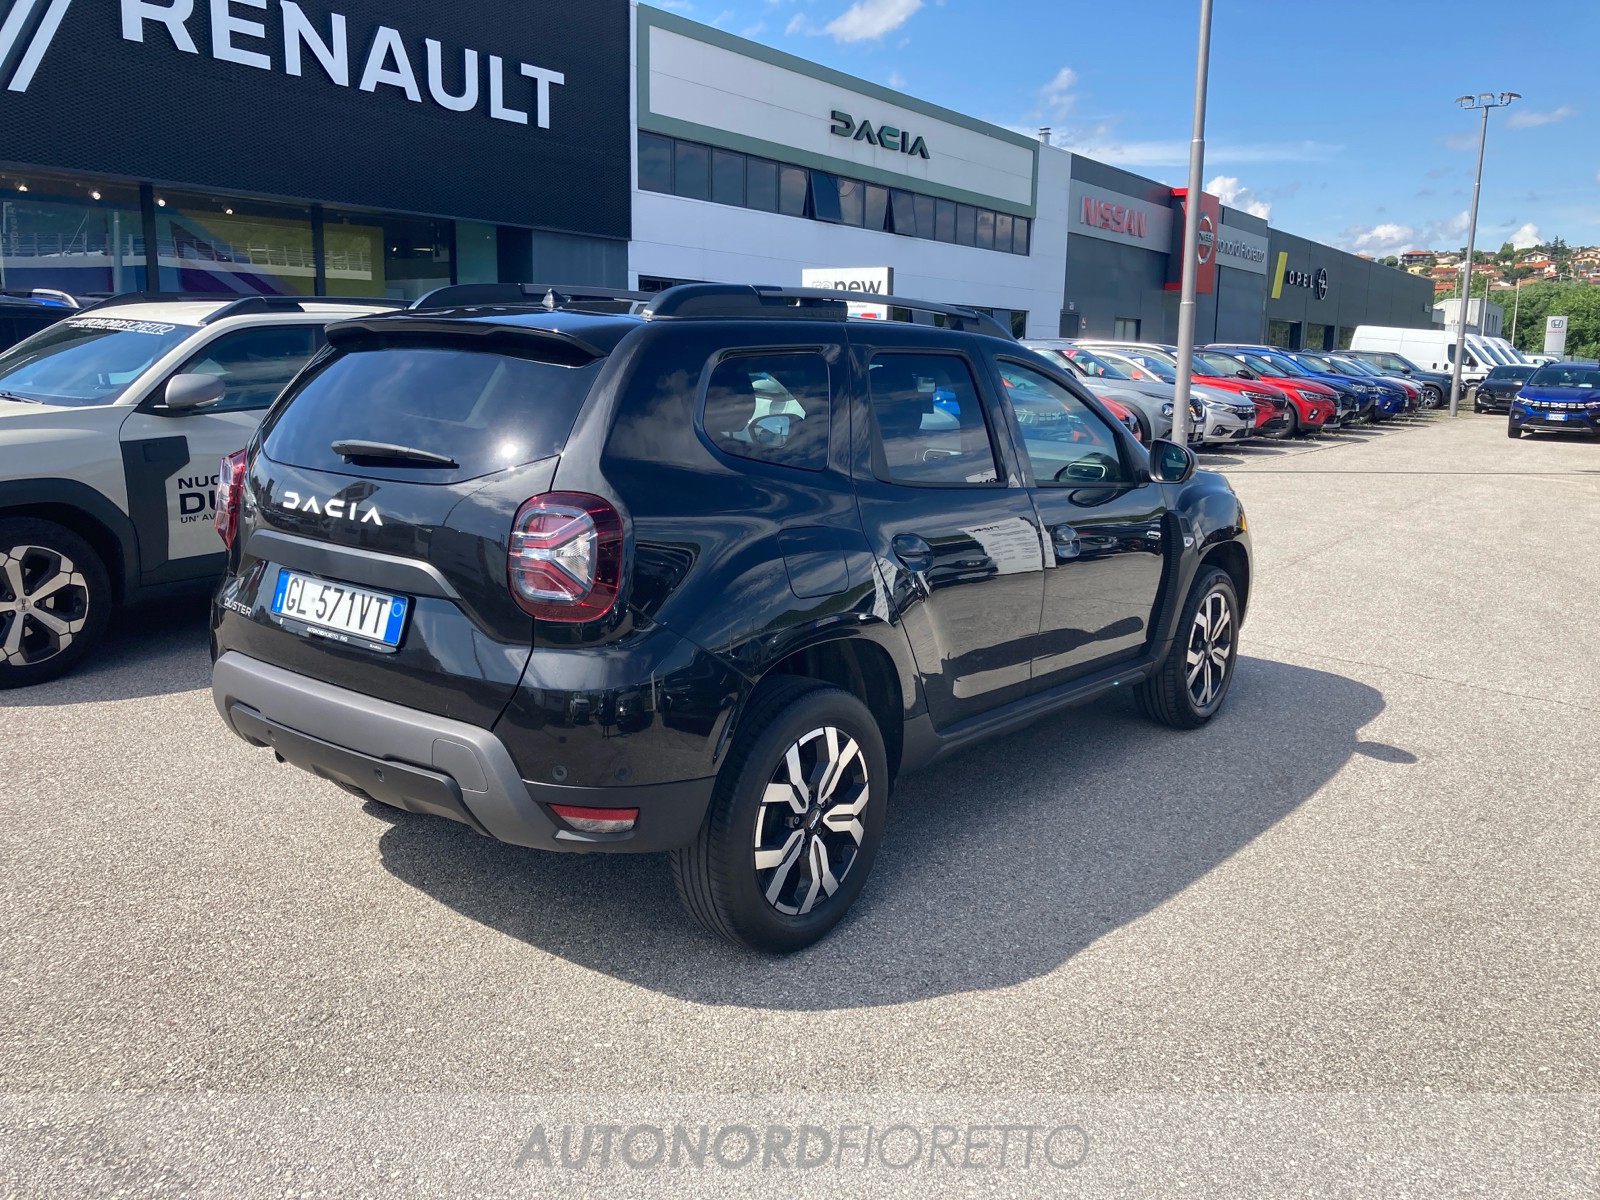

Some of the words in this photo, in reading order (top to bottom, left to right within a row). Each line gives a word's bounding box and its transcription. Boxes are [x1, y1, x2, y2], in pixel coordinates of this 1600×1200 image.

[121, 0, 565, 129] RENAULT
[830, 110, 931, 160] DACIA
[1080, 195, 1147, 238] NISSAN
[1288, 270, 1313, 289] OPEL
[282, 490, 383, 526] DACIA
[224, 597, 252, 617] DUSTER
[285, 577, 306, 616] GL
[315, 584, 389, 635] 571VT
